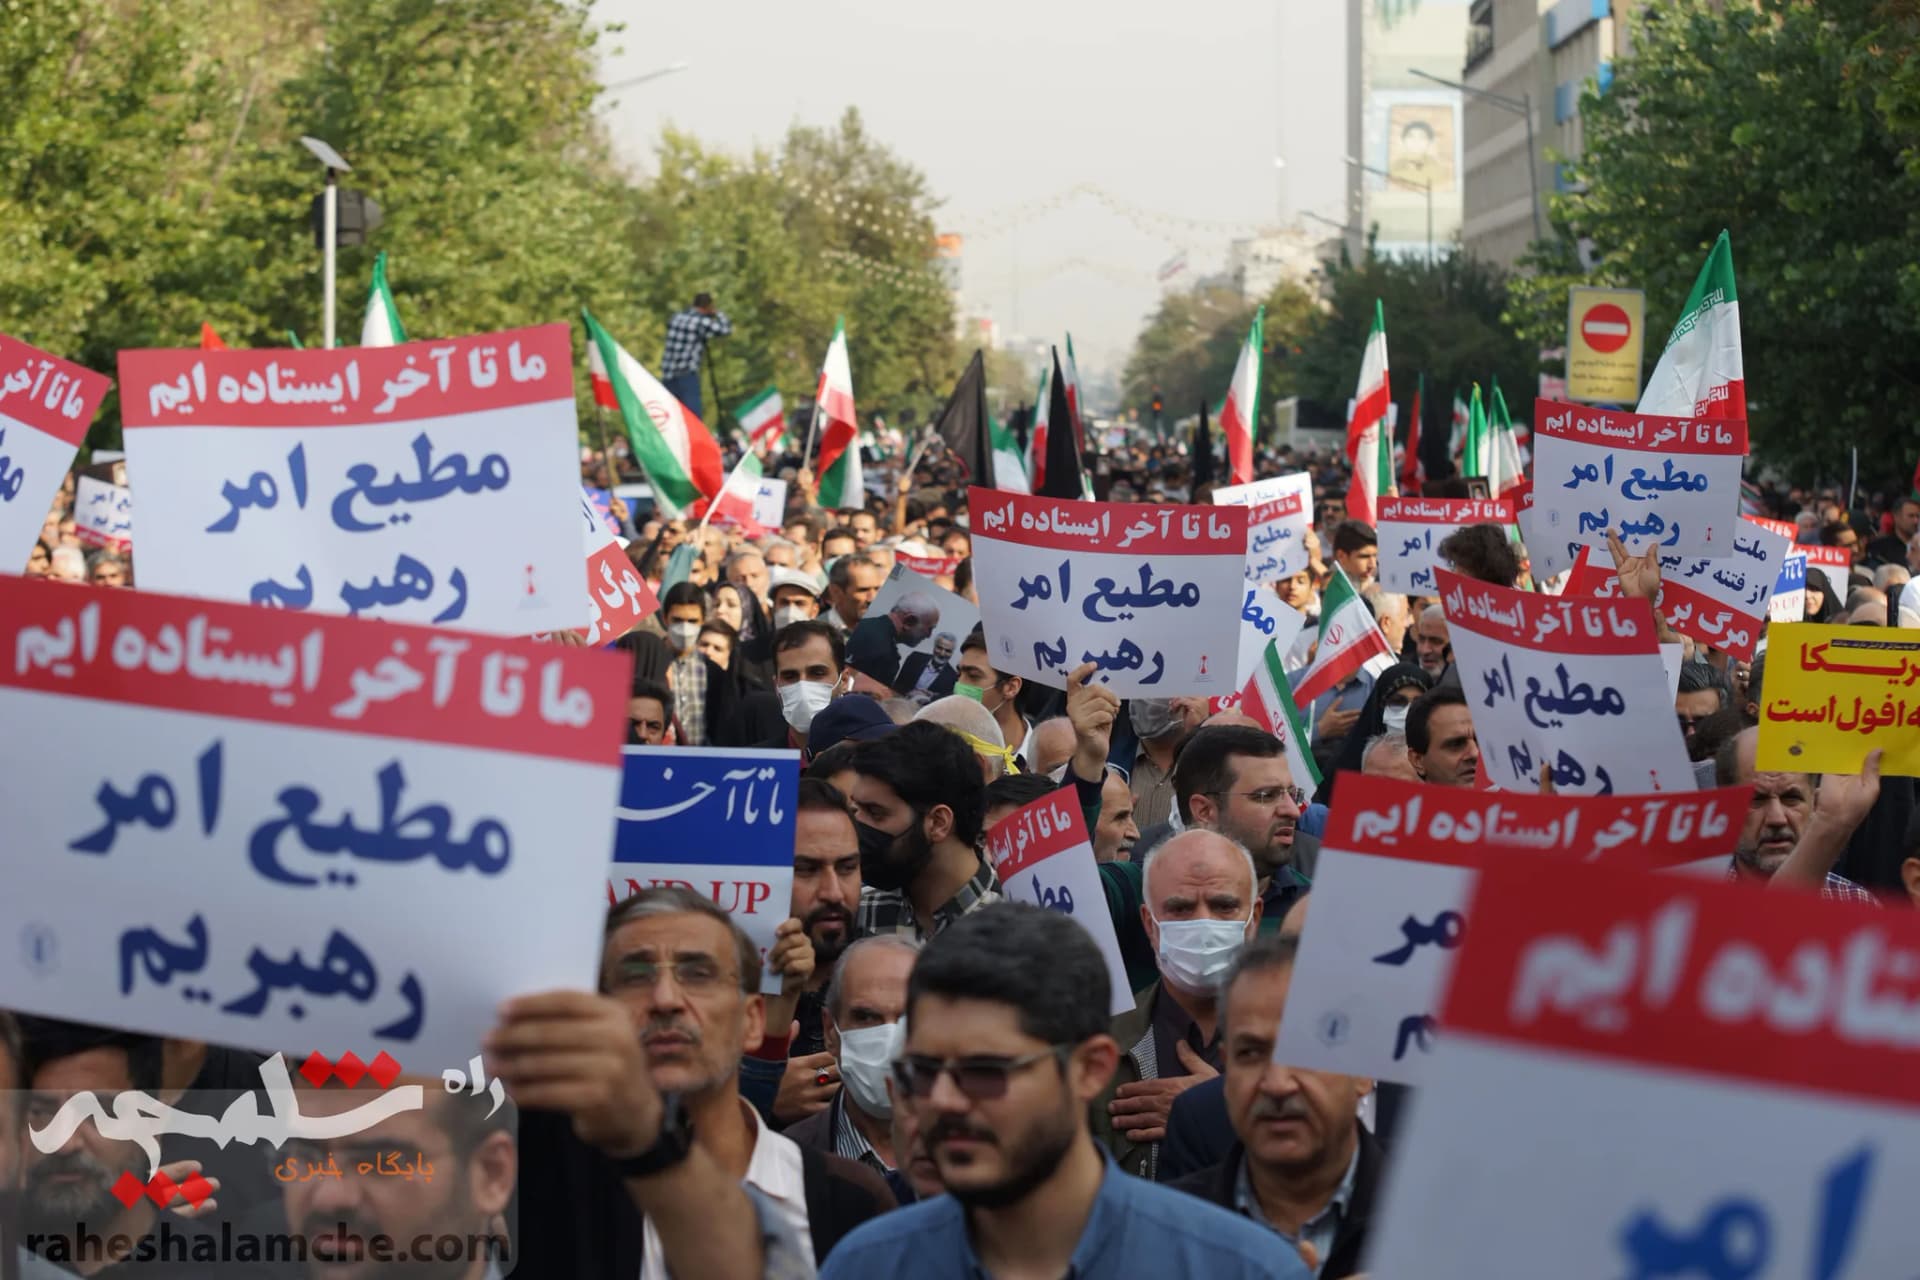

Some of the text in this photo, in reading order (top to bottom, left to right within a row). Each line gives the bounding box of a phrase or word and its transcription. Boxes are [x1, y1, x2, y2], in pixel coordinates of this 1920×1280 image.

[44, 372, 69, 410] تا
[61, 379, 84, 420] ما
[148, 340, 547, 418] ما تا آخر ایستاده ایم
[1546, 410, 1733, 447] ما تا آخر ایستاده ایم
[205, 440, 308, 533] امر
[330, 431, 511, 533] مطیع
[1563, 453, 1708, 501] مطیع امر
[983, 500, 1014, 535] ایم
[1021, 510, 1110, 541] ایستاده
[1115, 508, 1175, 549] آخر
[1182, 512, 1200, 541] تا
[1208, 512, 1231, 540] ما
[1383, 501, 1507, 522] ما تا آخر ایستاده ایم
[1578, 507, 1680, 546] رهبریم
[1398, 528, 1431, 557] امر
[1733, 536, 1768, 561] ملت
[1684, 559, 1711, 577] گر
[1712, 568, 1746, 592] فتنه
[1010, 559, 1200, 622] مطیع امر
[1745, 584, 1768, 605] از
[1446, 583, 1638, 643] ما تا آخر ایستاده ایم
[1666, 602, 1749, 648] مرگ بر
[14, 602, 596, 729] ما تا آخر ایستاده ایم
[1033, 635, 1165, 686] رهبریم
[1482, 652, 1626, 729] مطیع امر
[1766, 695, 1837, 723] است
[1836, 693, 1906, 735] افول
[67, 736, 513, 889] مطیع امر
[769, 781, 784, 825] ما
[1036, 807, 1051, 839] تا
[1050, 802, 1072, 832] ما
[1016, 808, 1036, 863] آخر
[1352, 796, 1729, 862] ما تا آخر ایستاده ایم
[708, 880, 771, 914] UP
[1372, 910, 1466, 966] مر
[117, 911, 426, 1043] رهبریم
[1507, 895, 1697, 1034] ایم
